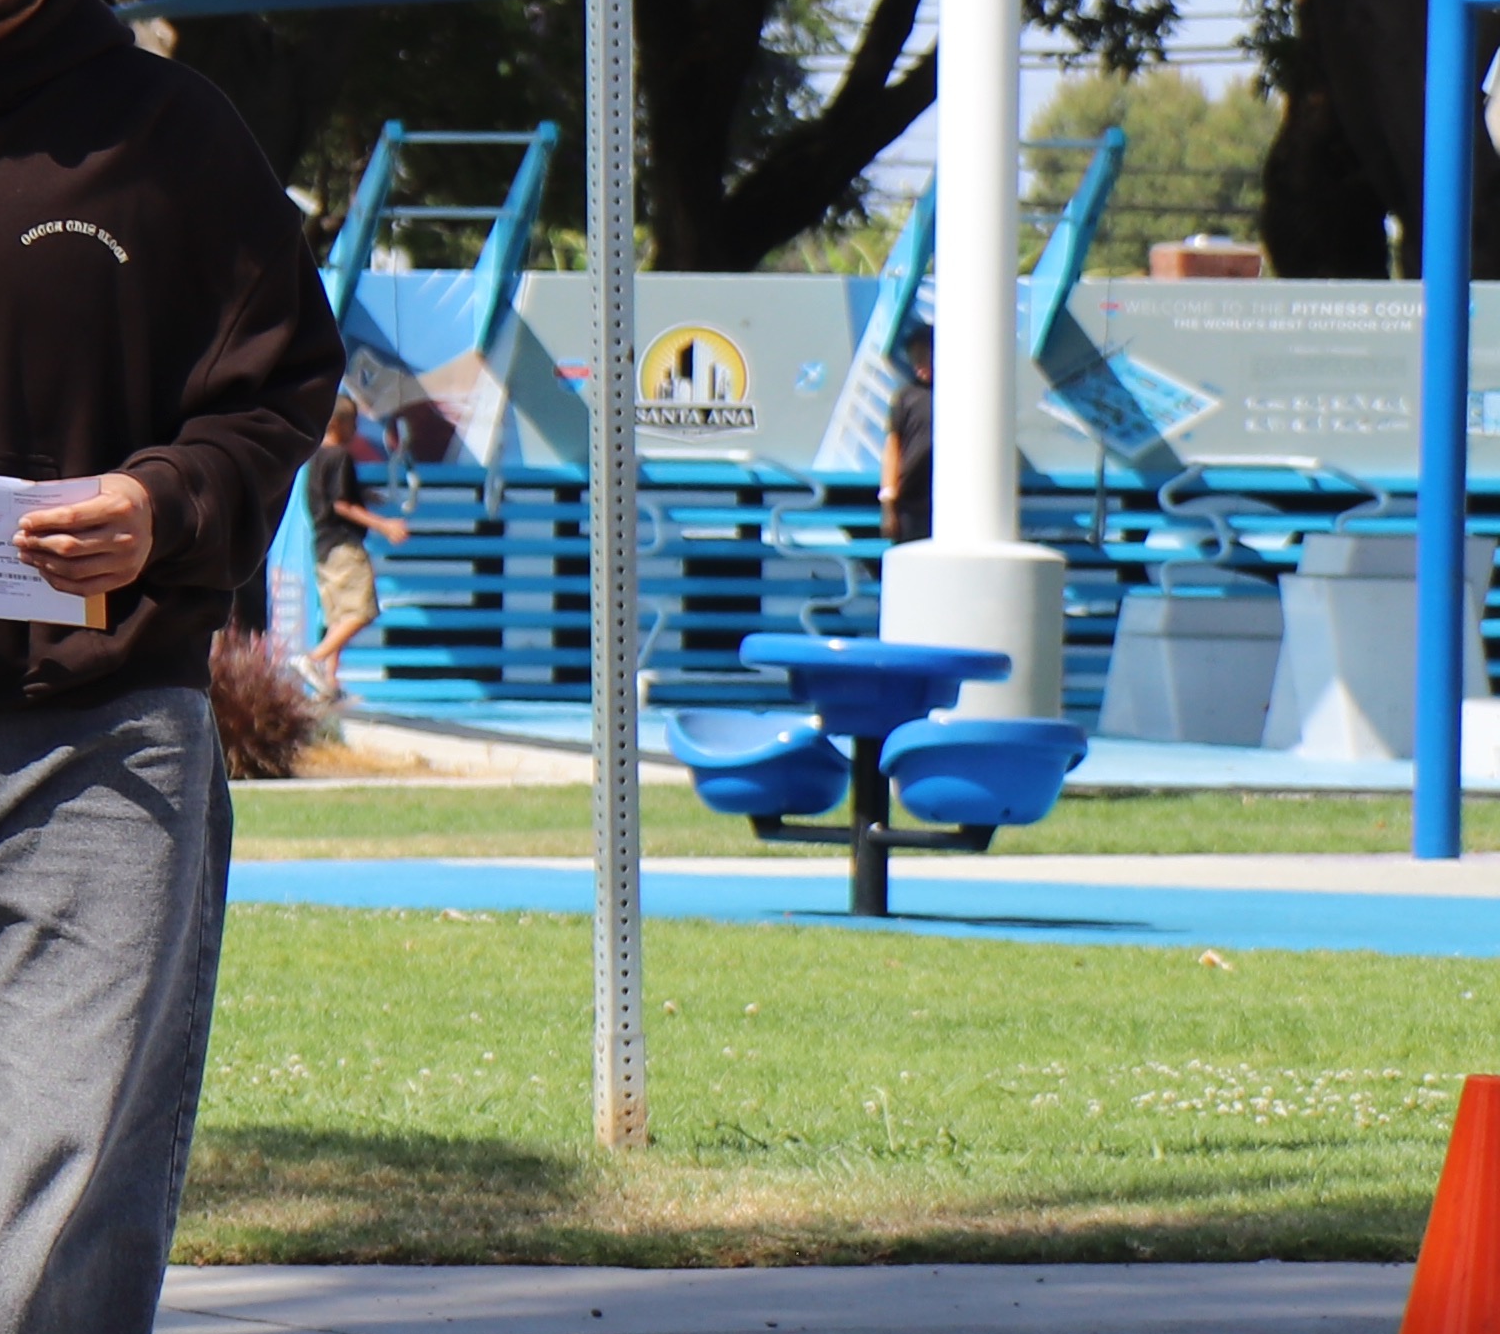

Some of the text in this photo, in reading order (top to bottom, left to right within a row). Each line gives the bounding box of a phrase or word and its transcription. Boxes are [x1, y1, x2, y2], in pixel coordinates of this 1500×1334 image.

[1290, 301, 1369, 316] FITNESS
[1174, 319, 1199, 330] THE
[1270, 320, 1303, 331] BEST
[635, 409, 748, 423] SANTA ANA
